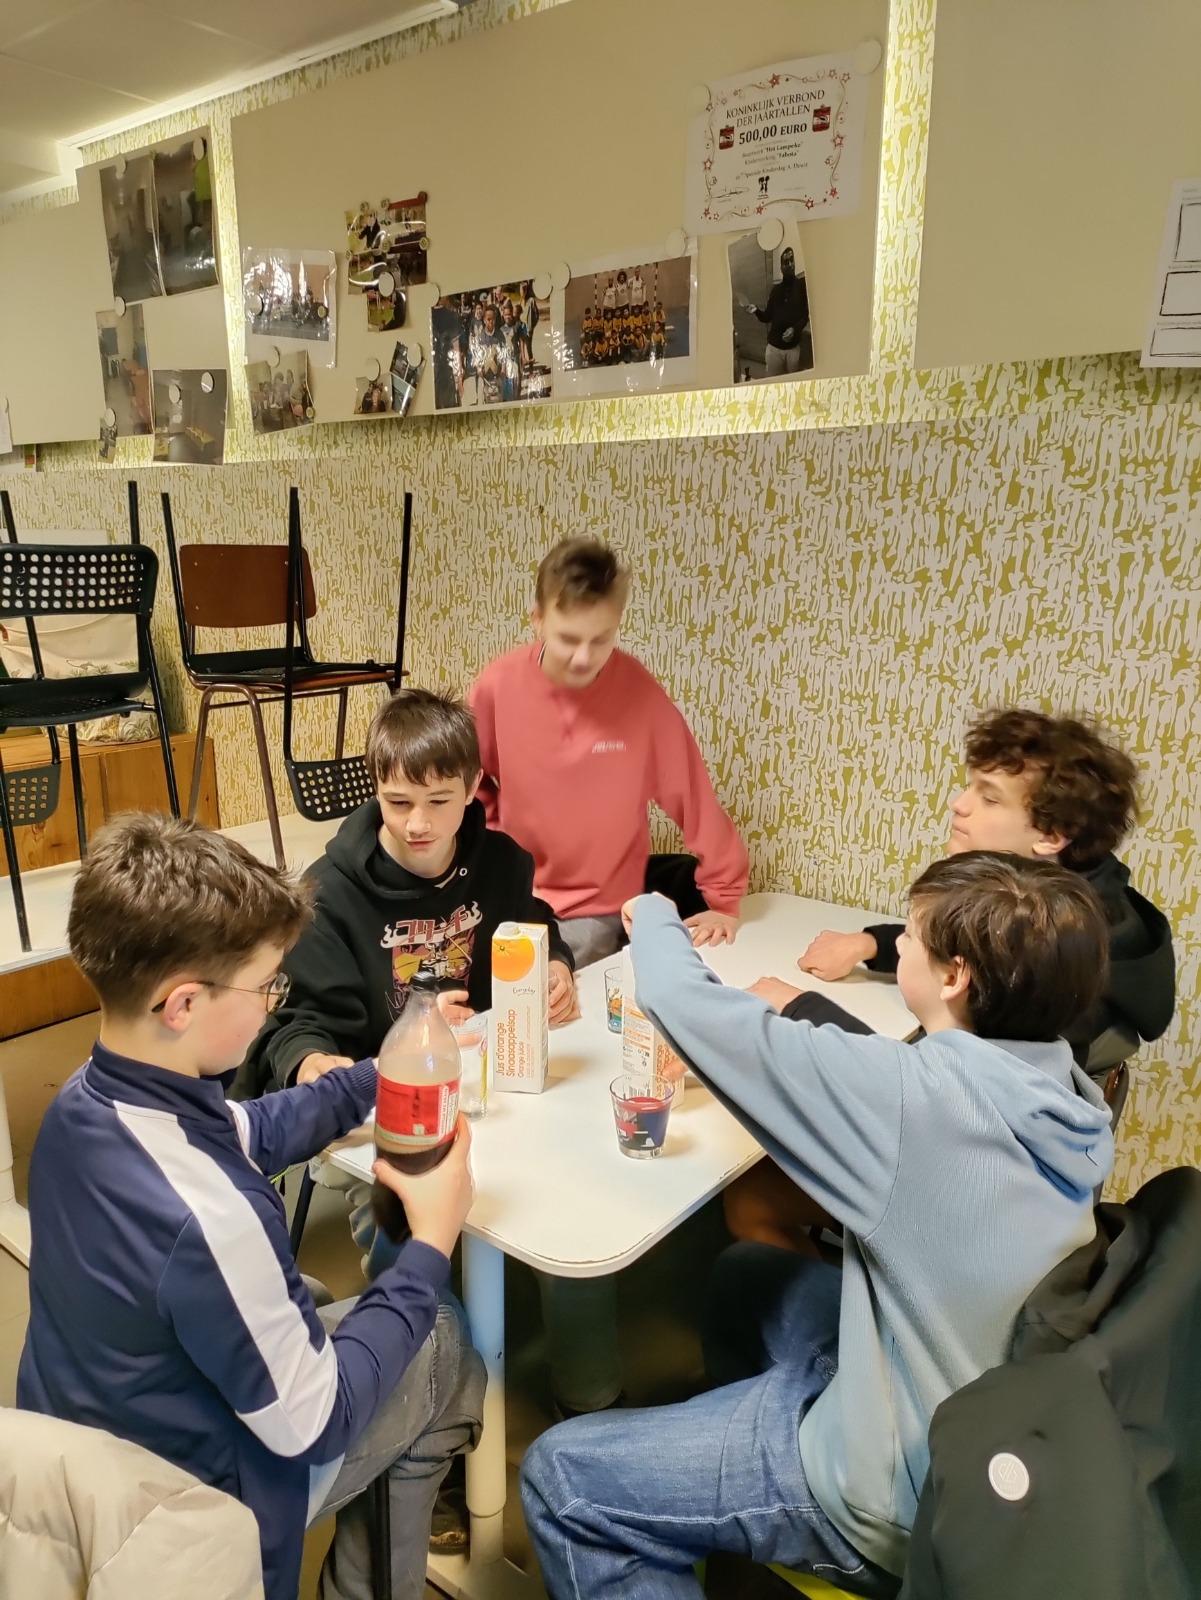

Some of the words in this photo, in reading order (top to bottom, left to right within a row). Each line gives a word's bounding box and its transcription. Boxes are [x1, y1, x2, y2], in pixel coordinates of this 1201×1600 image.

[726, 99, 775, 119] KONINKLIJK
[777, 89, 825, 106] VERBOND
[736, 115, 753, 127] DER
[754, 104, 811, 125] JAARTALLEN
[739, 124, 777, 145] 500,00
[780, 122, 807, 136] EURO
[496, 1022, 506, 1061] d'orange
[506, 1009, 517, 1077] Sinaasappelsap
[496, 1062, 505, 1076] Jus
